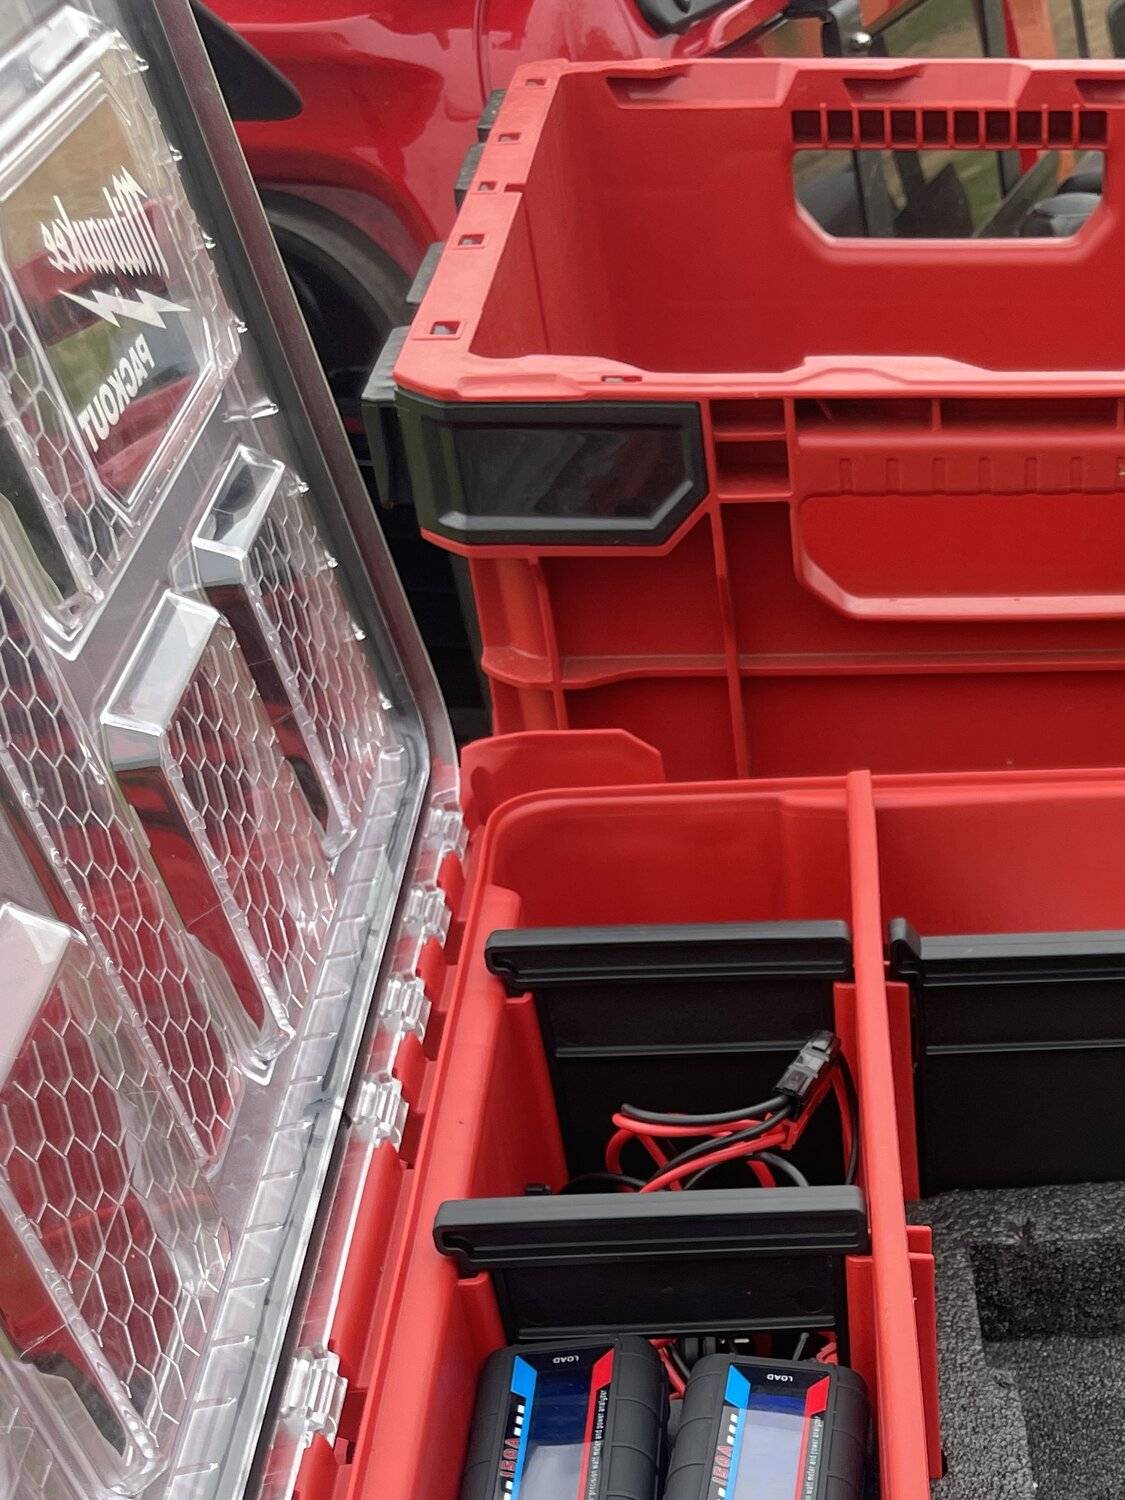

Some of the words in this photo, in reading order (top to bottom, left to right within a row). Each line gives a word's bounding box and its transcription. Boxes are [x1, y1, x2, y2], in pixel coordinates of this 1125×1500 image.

[552, 1355, 580, 1364] LOAD
[766, 1373, 794, 1382] LOAD
[596, 1413, 605, 1429] power
[594, 1429, 604, 1440] and
[500, 1437, 521, 1479] 150A
